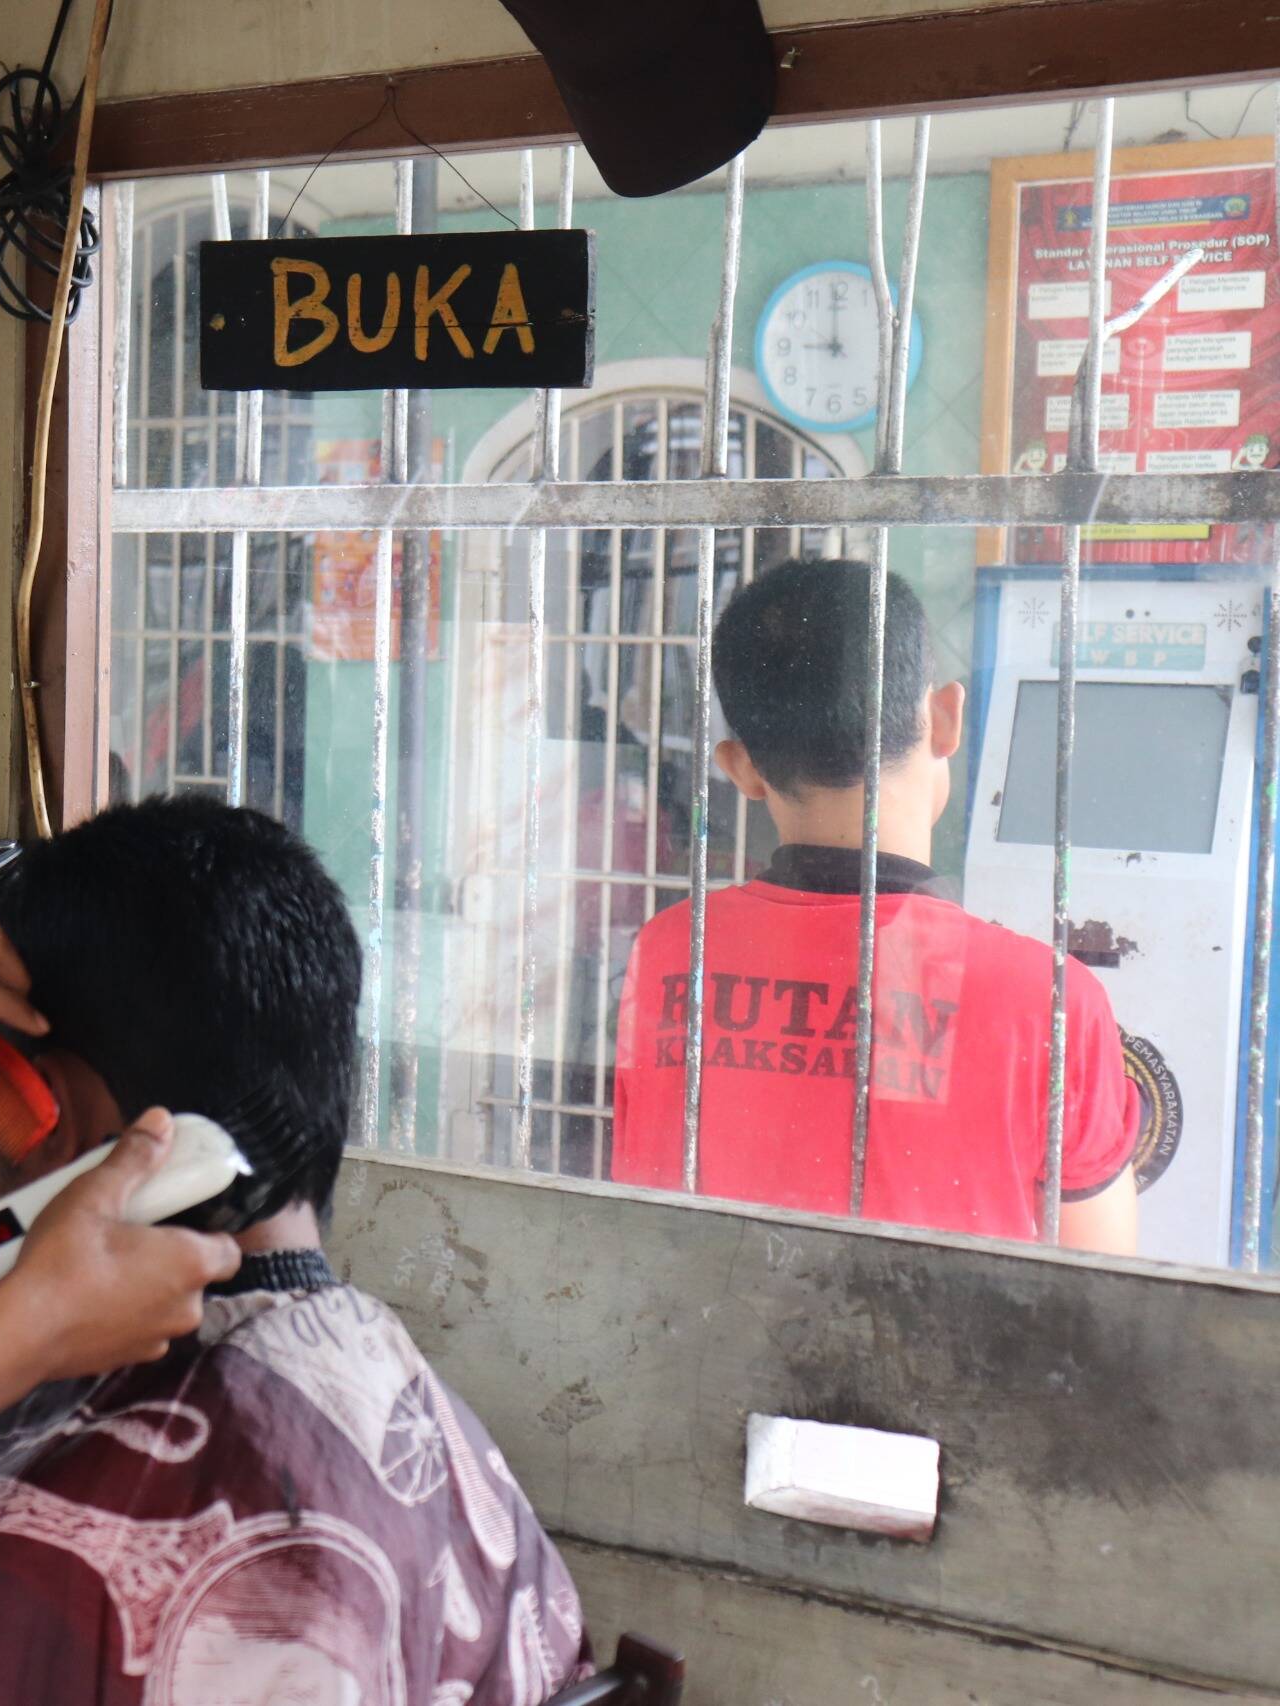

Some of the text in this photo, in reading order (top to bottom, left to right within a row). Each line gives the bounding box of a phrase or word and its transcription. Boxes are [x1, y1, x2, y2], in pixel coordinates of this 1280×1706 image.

[1035, 246, 1084, 259] Standar
[1231, 233, 1271, 249] (SOP)
[1136, 256, 1169, 270] SELF
[270, 257, 536, 368] BUKA
[777, 337, 792, 357] 9
[784, 366, 797, 386] 8
[805, 387, 817, 407] 7
[827, 394, 841, 414] 6
[853, 387, 867, 406] 5
[1113, 623, 1206, 645] SERVICE
[1124, 1032, 1179, 1157] PEMASYARAKATAN
